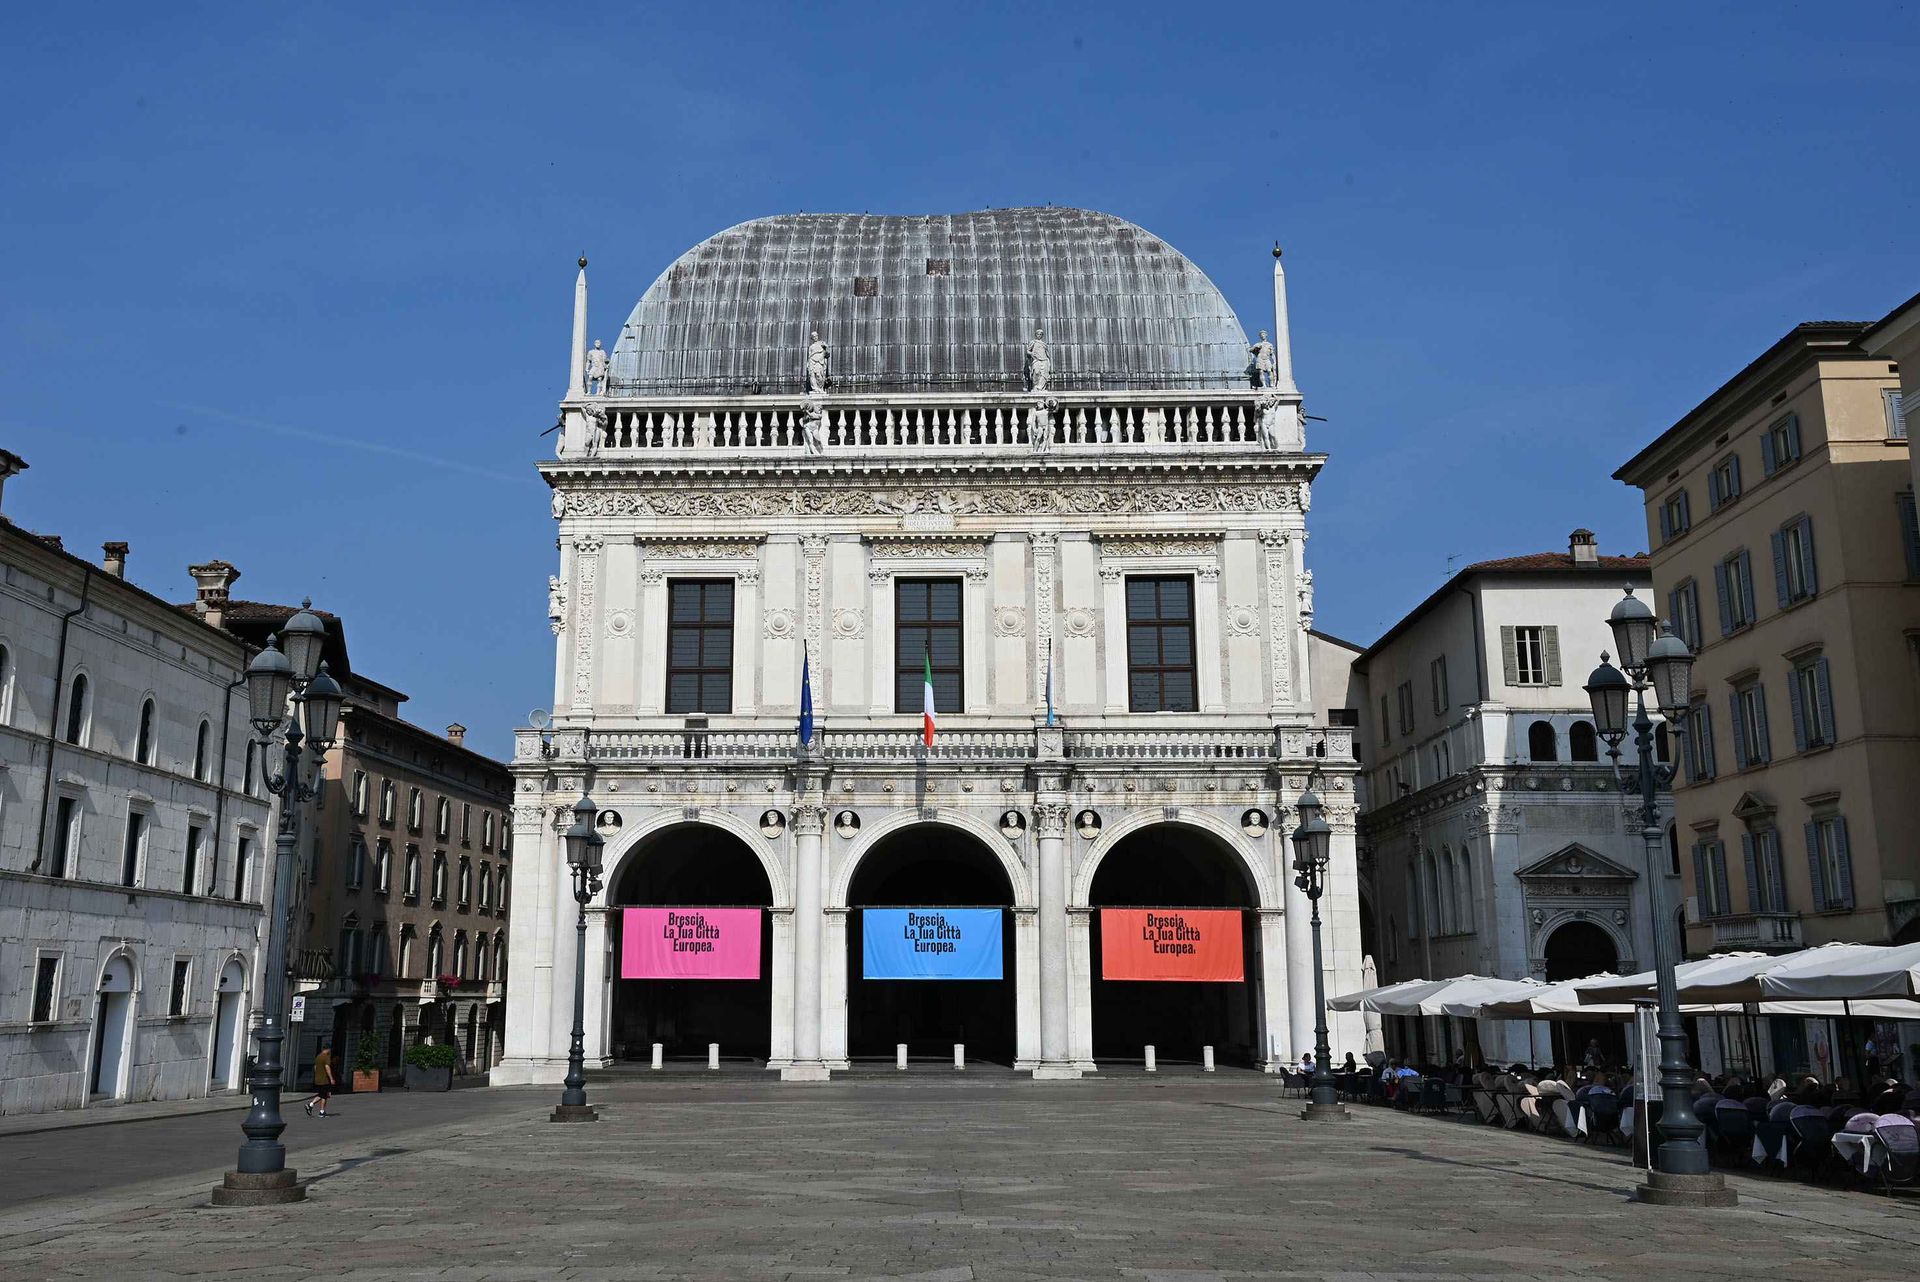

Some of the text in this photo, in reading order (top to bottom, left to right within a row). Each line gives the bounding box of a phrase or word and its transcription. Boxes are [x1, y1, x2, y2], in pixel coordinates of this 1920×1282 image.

[664, 925, 720, 939] La Tua Città
[904, 926, 961, 939] La Tua Città
[1143, 927, 1200, 941] La Tua Città
[673, 938, 715, 955] Europea.
[914, 939, 956, 955] Europea.
[1153, 940, 1196, 957] Europea.
